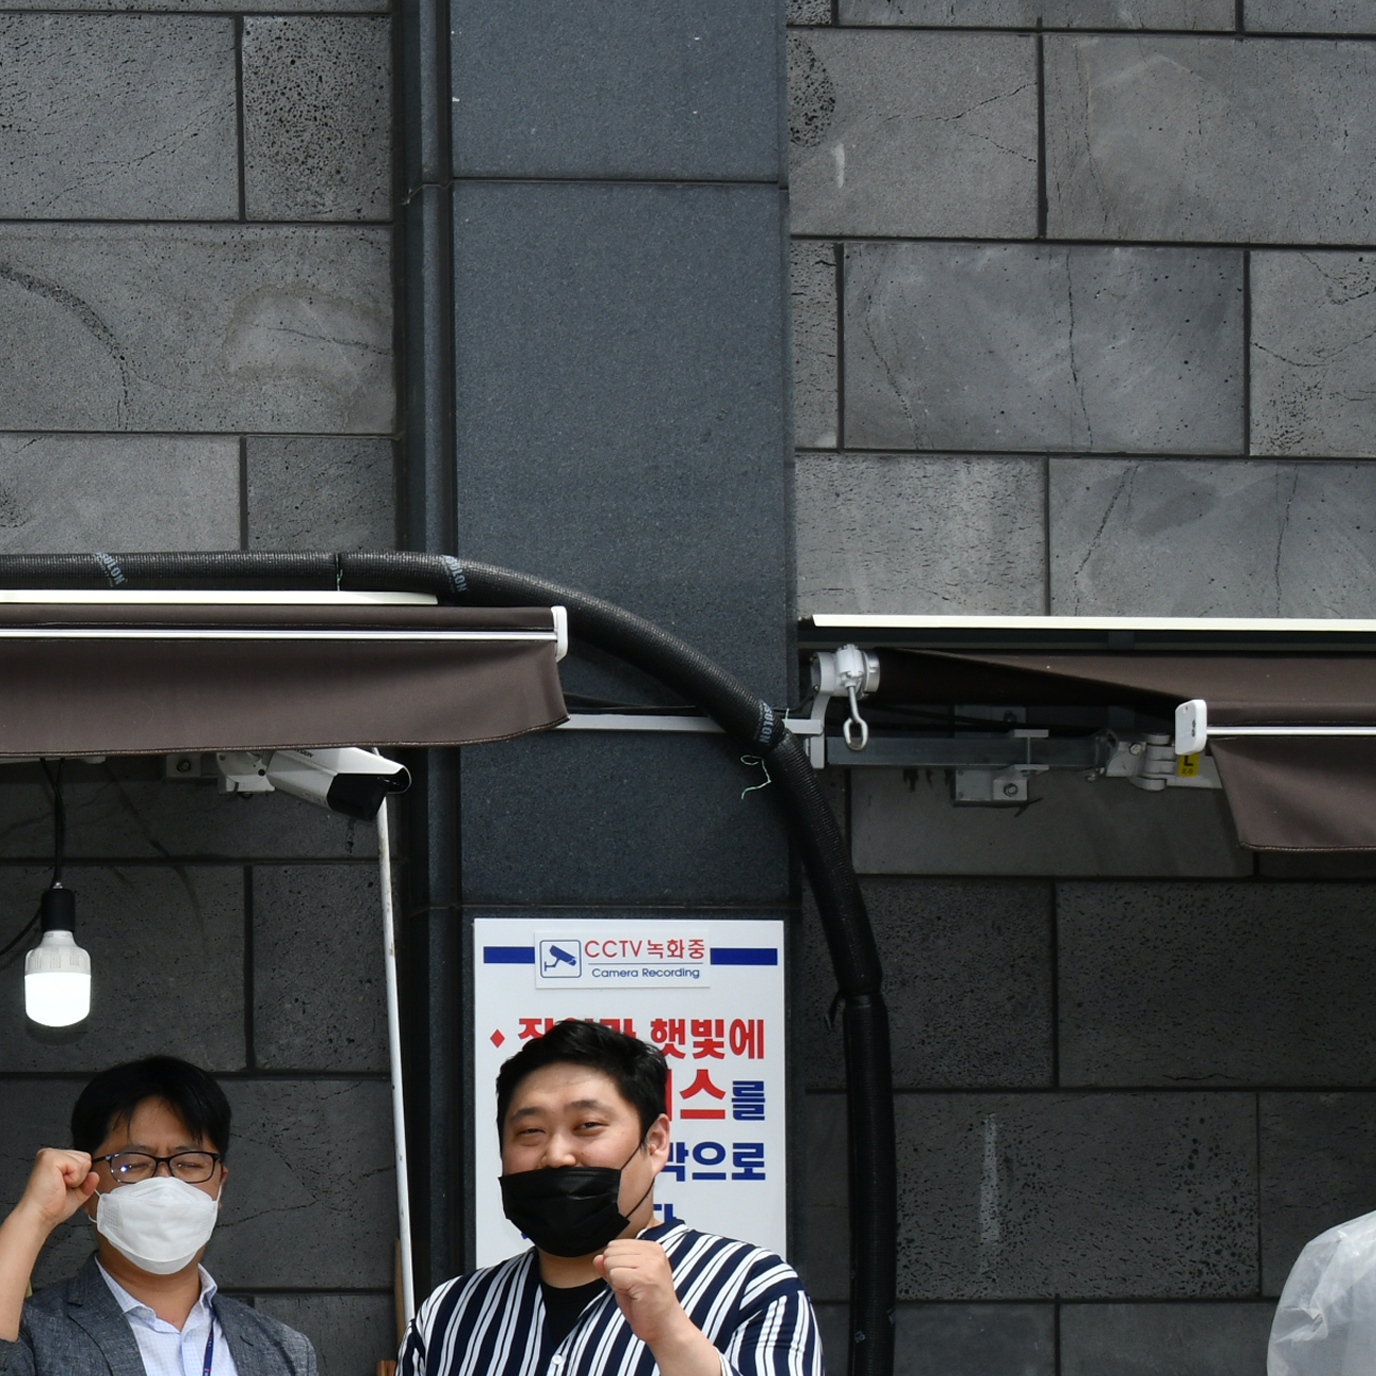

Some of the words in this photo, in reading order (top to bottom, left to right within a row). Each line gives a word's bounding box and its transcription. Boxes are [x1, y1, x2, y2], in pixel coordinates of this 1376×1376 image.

[584, 940, 643, 959] CCTV
[646, 938, 705, 959] 녹화중
[591, 967, 639, 978] Camera
[641, 967, 701, 979] Recording
[650, 1018, 766, 1060] 햇빛에
